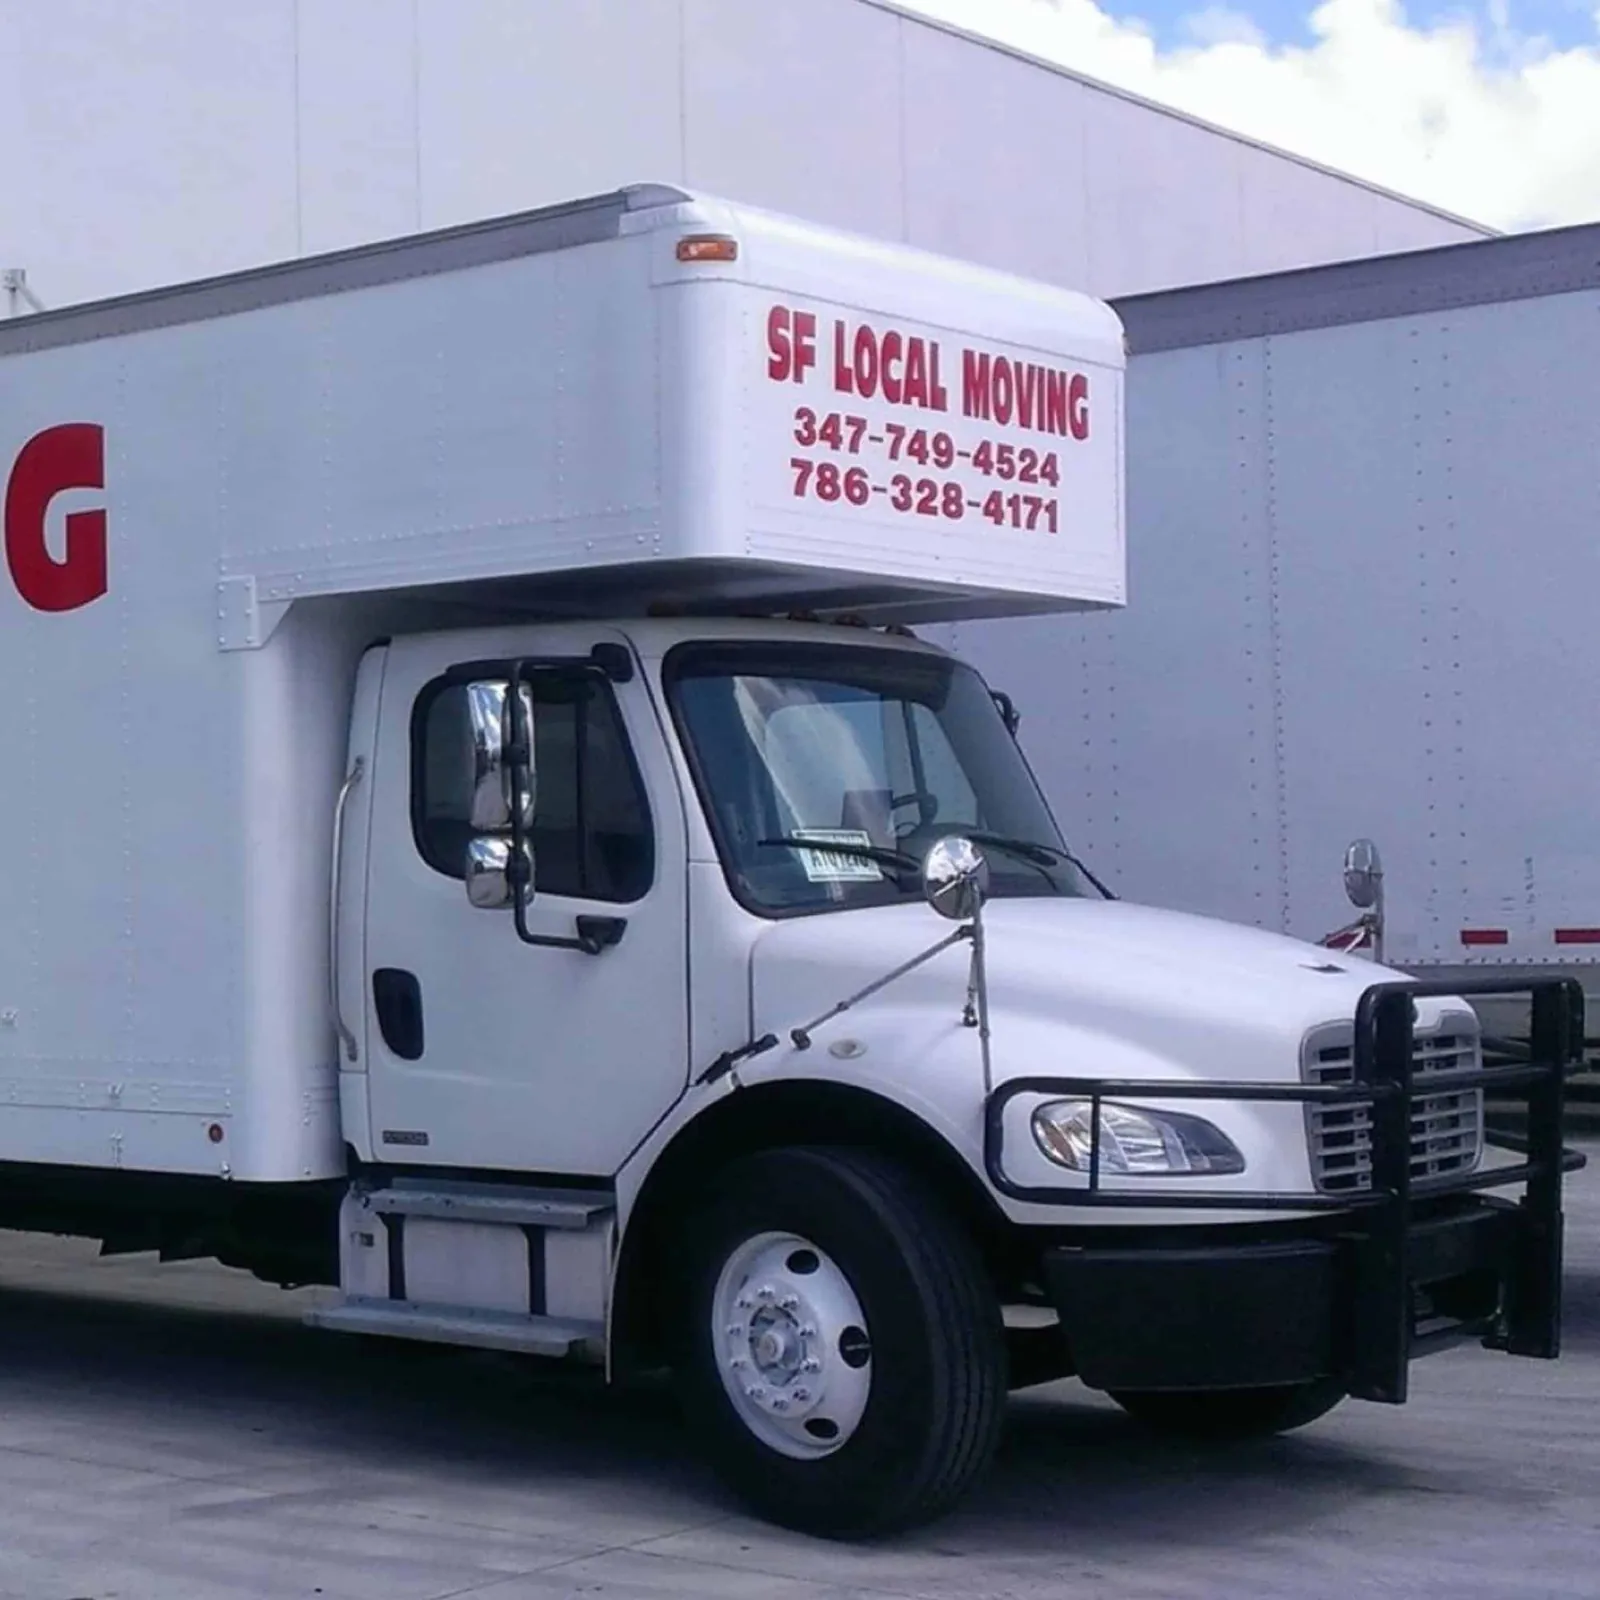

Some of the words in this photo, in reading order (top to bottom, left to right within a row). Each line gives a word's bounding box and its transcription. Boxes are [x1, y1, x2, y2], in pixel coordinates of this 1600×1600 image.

[767, 305, 816, 384] SF
[834, 319, 948, 412] LOCAL
[963, 348, 1089, 440] MOVING
[791, 458, 1058, 534] 786-328-4171
[794, 407, 1060, 488] 347-749-4524
[5, 423, 107, 612] G
